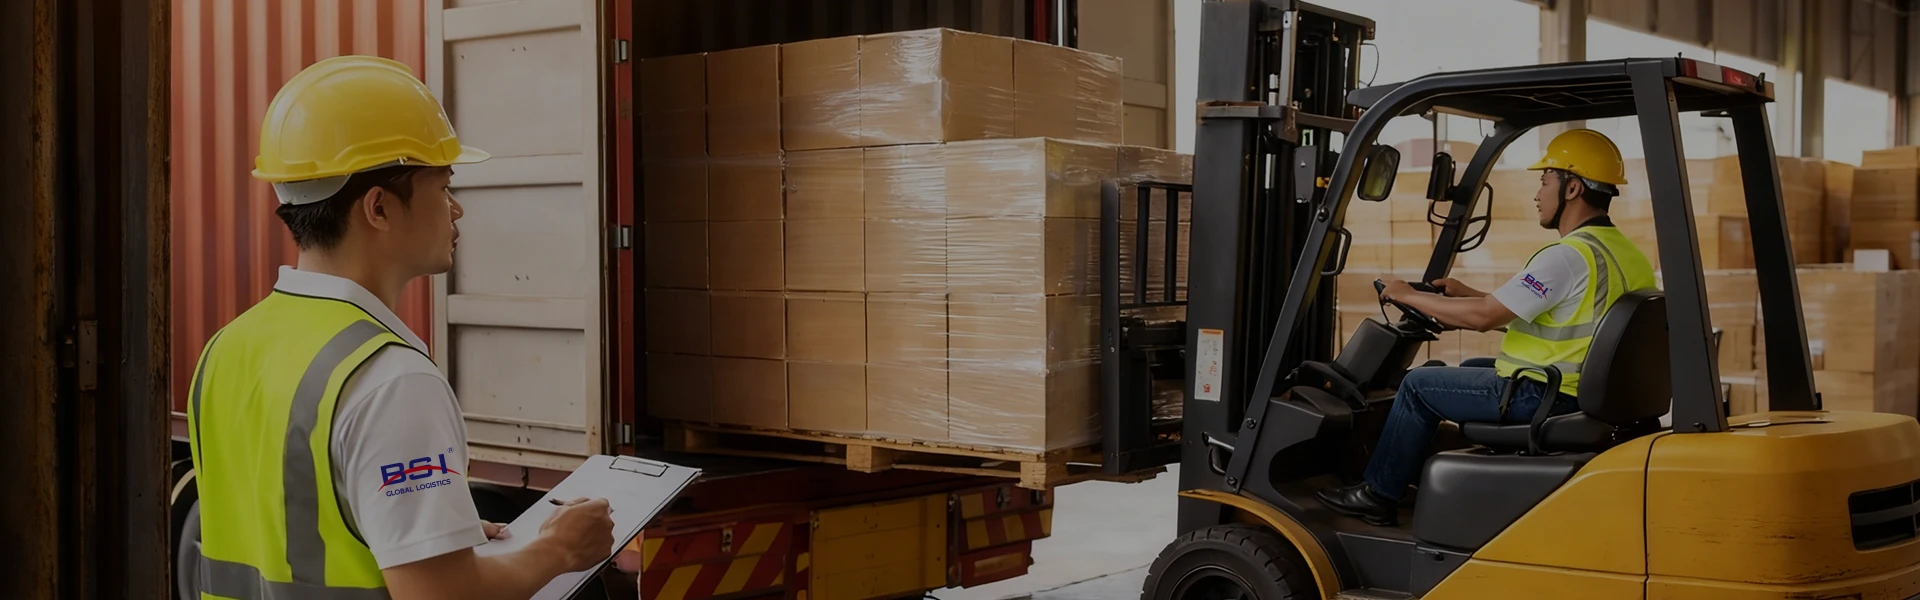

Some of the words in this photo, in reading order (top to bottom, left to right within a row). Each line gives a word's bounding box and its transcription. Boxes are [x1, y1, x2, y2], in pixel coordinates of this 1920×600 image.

[1524, 273, 1548, 295] BSI
[380, 453, 448, 486] BSI
[386, 486, 414, 497] GLOBAL
[415, 478, 451, 491] LOGISTICS
